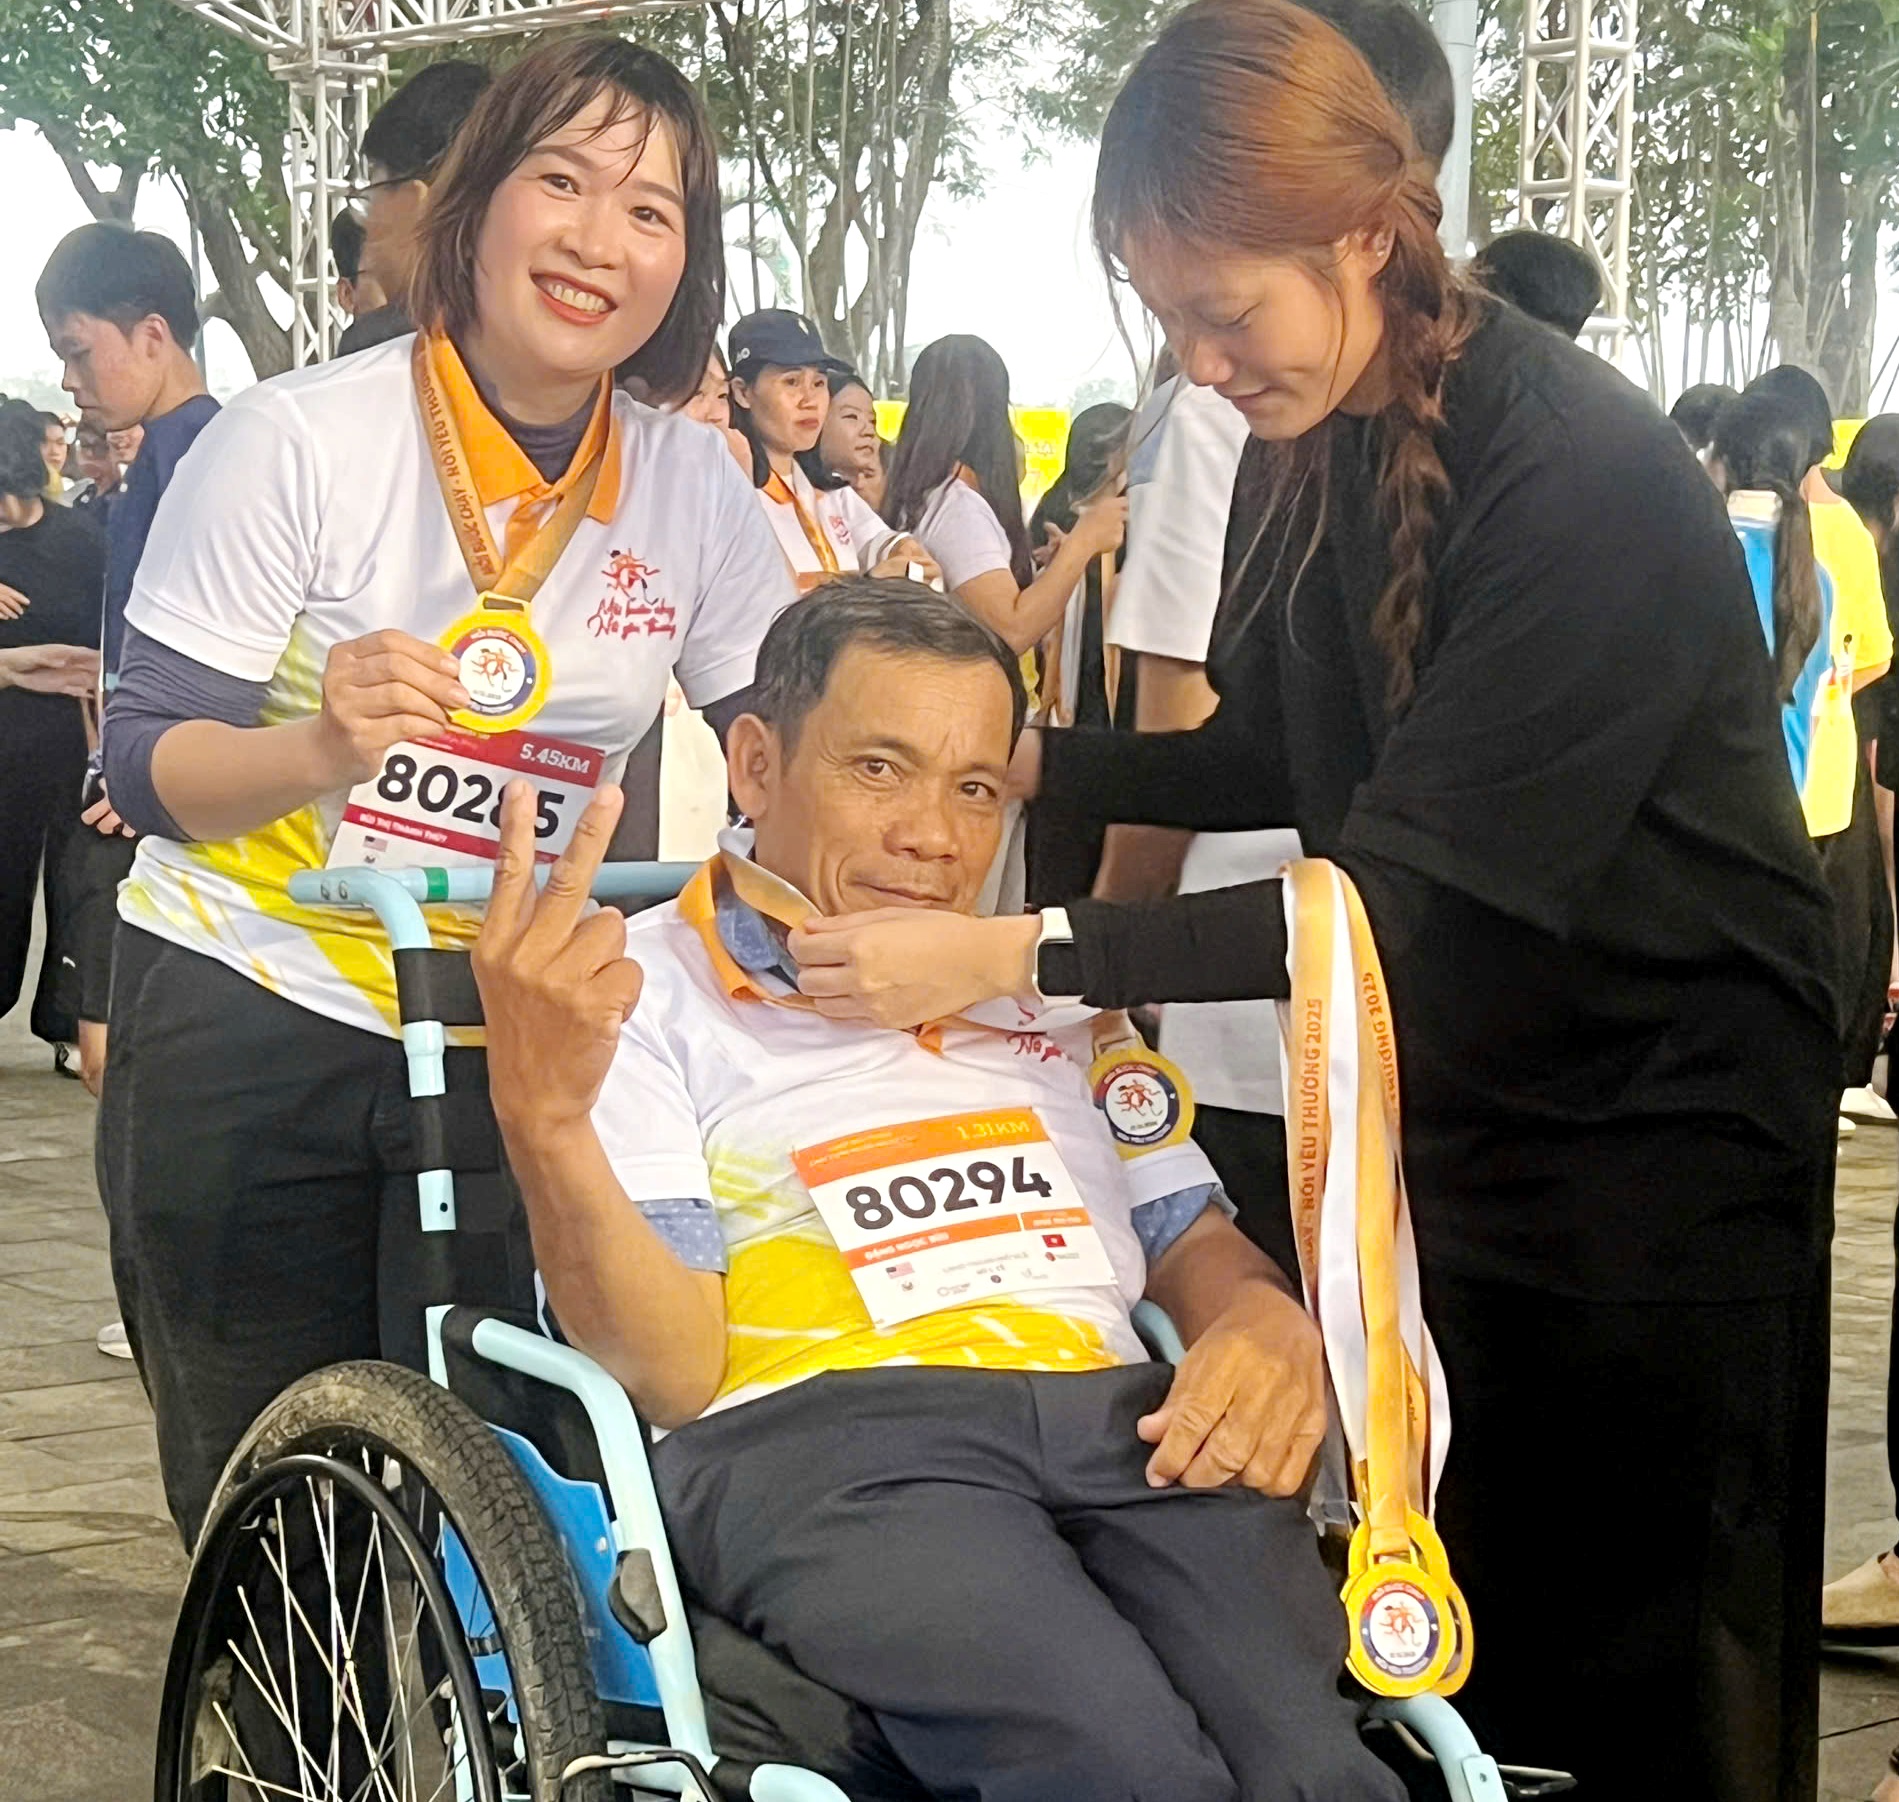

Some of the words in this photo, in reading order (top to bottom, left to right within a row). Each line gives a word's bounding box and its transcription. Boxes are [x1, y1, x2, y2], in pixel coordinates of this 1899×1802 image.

[520, 742, 591, 774] 5.45KM
[377, 754, 565, 838] 8025
[1306, 999, 1323, 1044] 2025
[845, 1156, 1053, 1230] 80294
